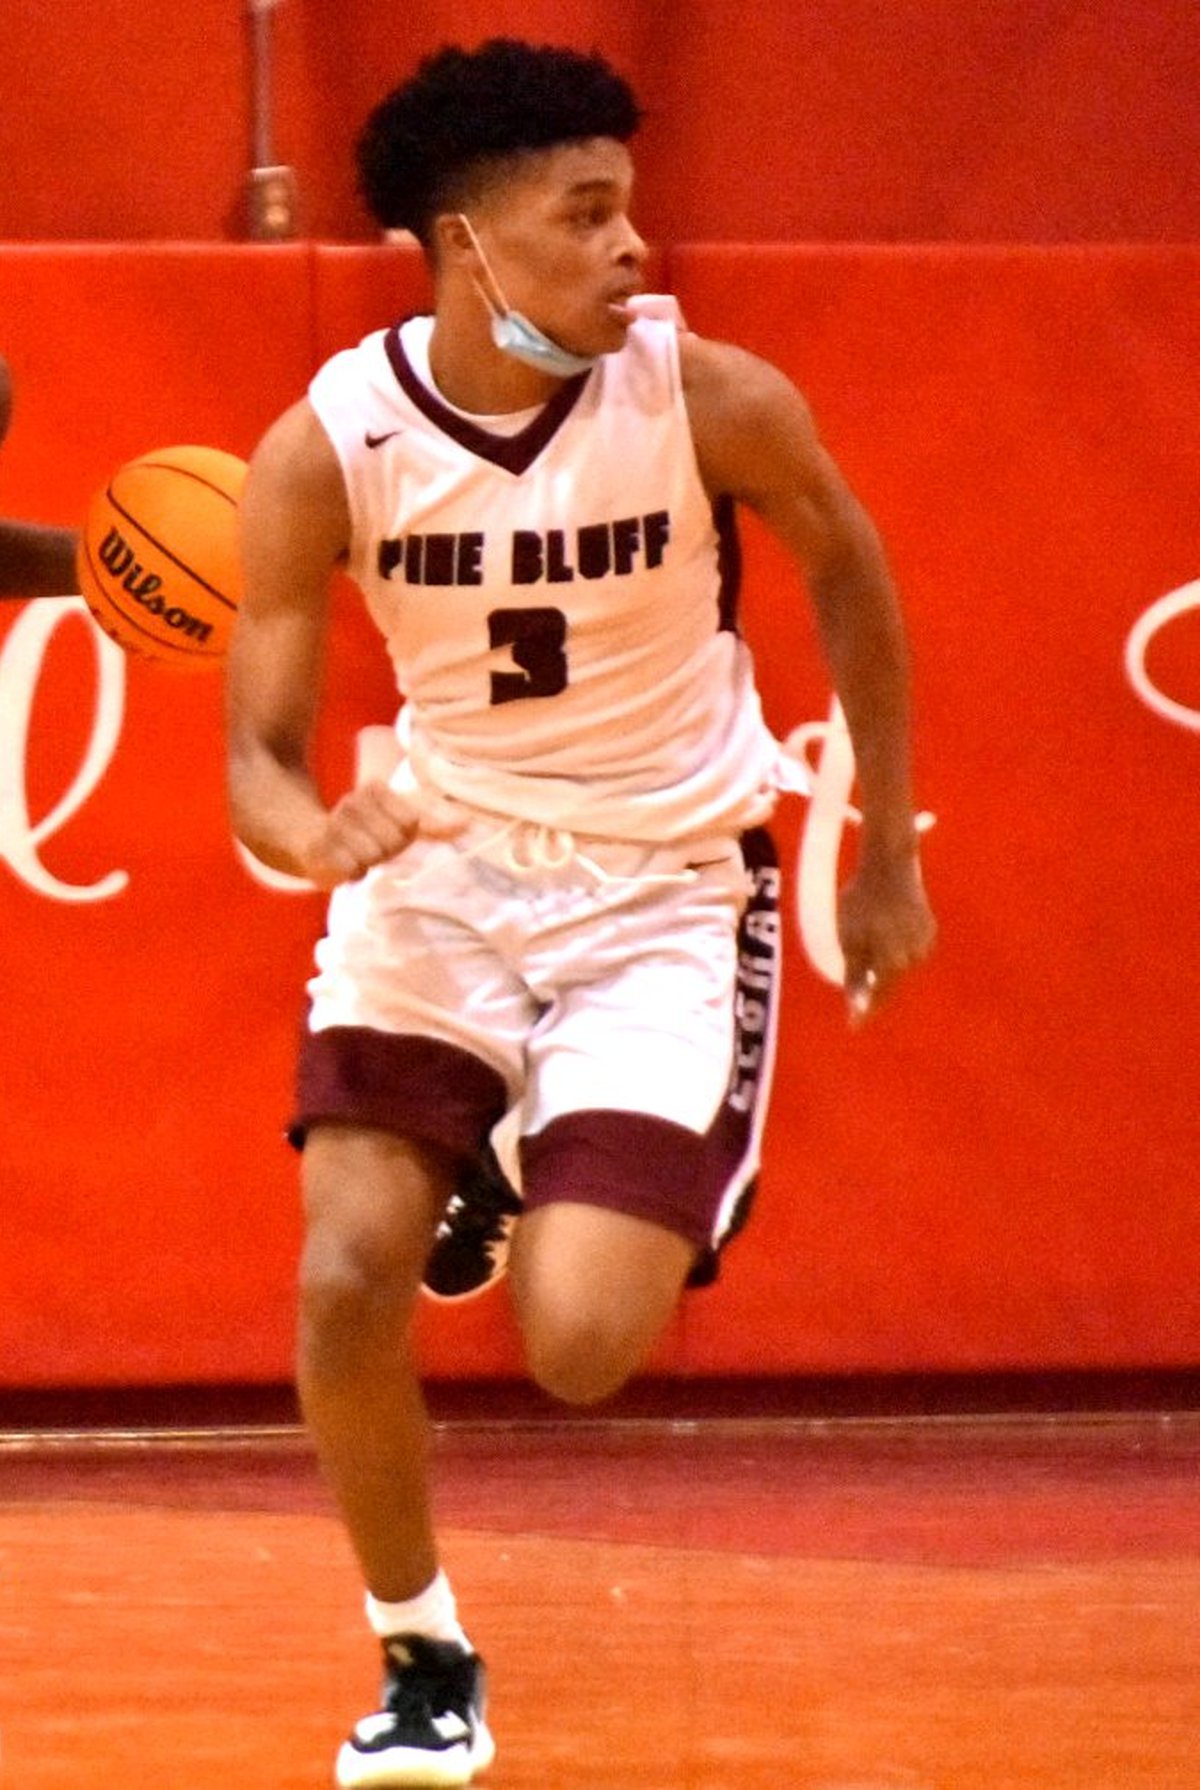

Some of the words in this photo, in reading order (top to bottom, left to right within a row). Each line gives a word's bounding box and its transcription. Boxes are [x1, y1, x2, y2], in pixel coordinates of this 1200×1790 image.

[98, 525, 214, 643] Wilson
[377, 531, 484, 586] PINE
[511, 509, 670, 585] BLUFF
[487, 606, 569, 706] 3
